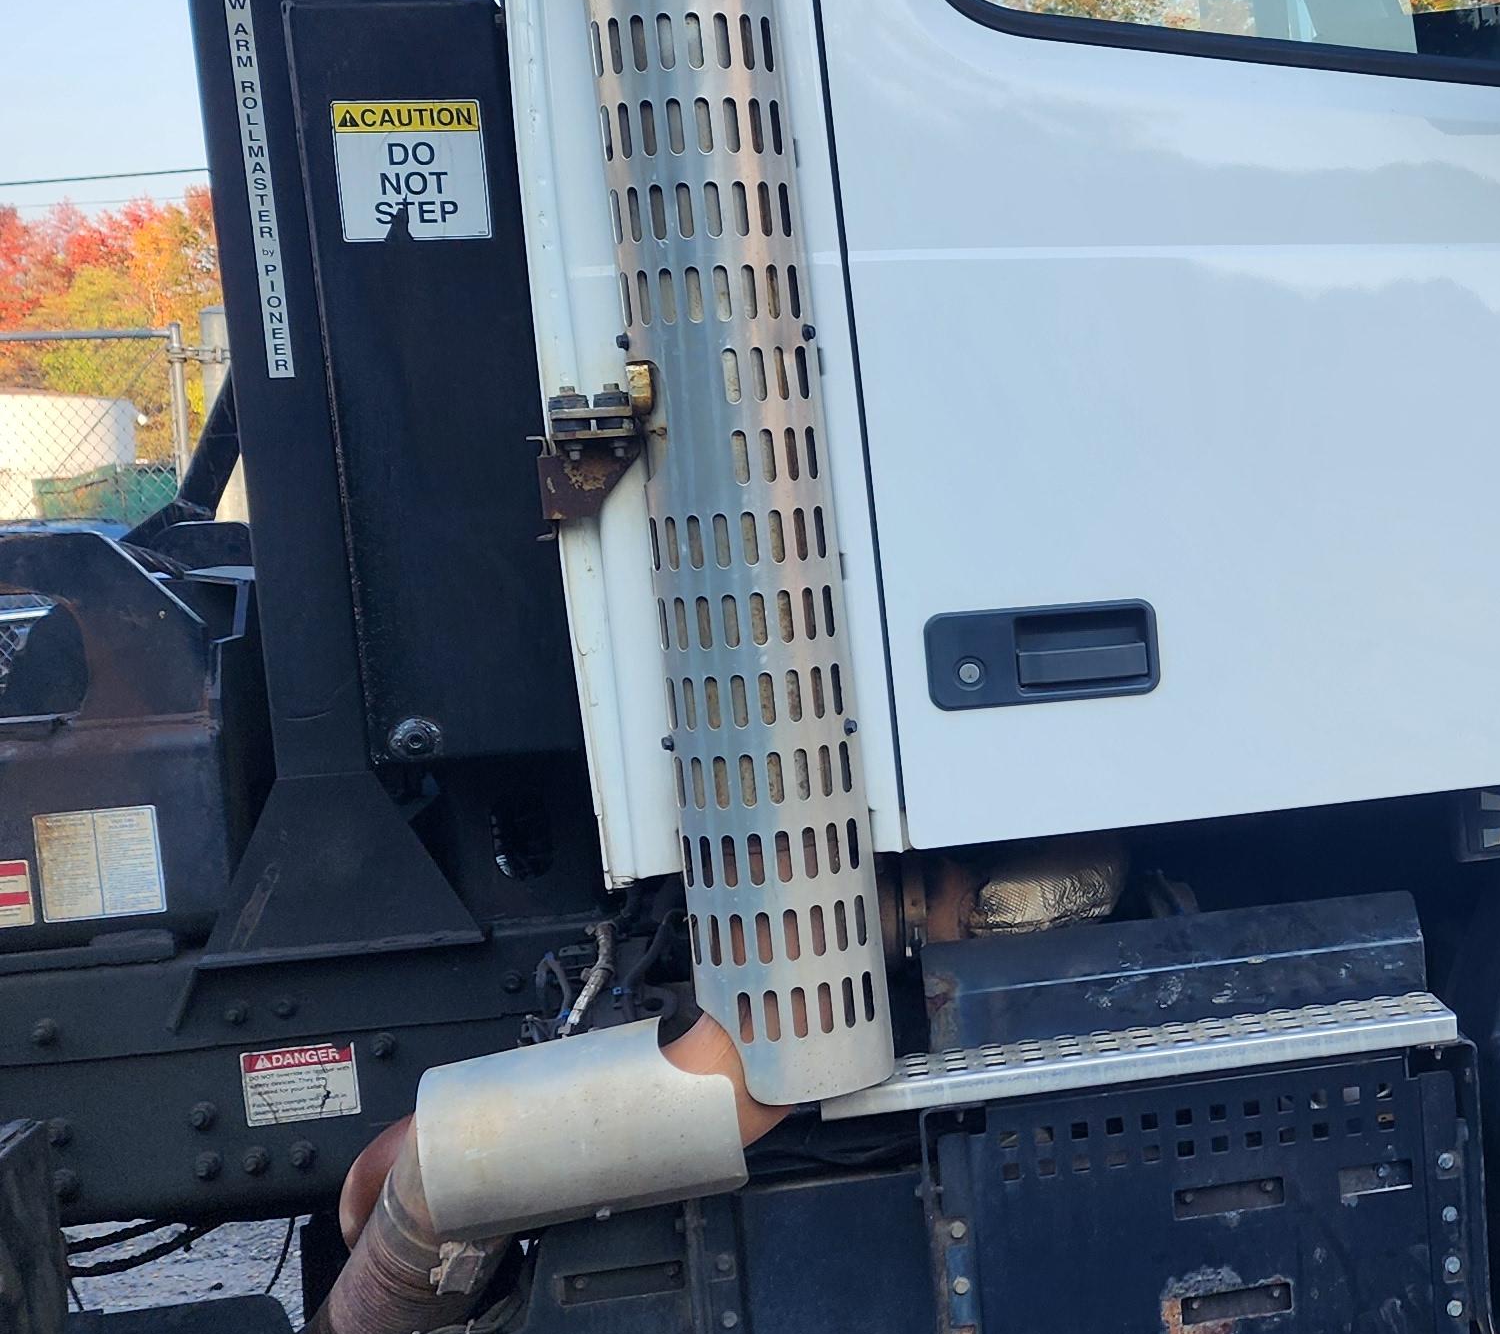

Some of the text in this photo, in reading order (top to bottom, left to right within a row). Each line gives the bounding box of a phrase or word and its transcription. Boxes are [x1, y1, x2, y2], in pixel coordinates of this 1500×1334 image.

[233, 22, 254, 68] ARM
[360, 107, 473, 127] CAUTION
[241, 80, 274, 239] ROLLMASTER
[387, 141, 435, 166] DO
[379, 171, 448, 196] NOT
[262, 248, 275, 258] by
[264, 264, 289, 372] PIONEER
[271, 1048, 340, 1067] DANGER
